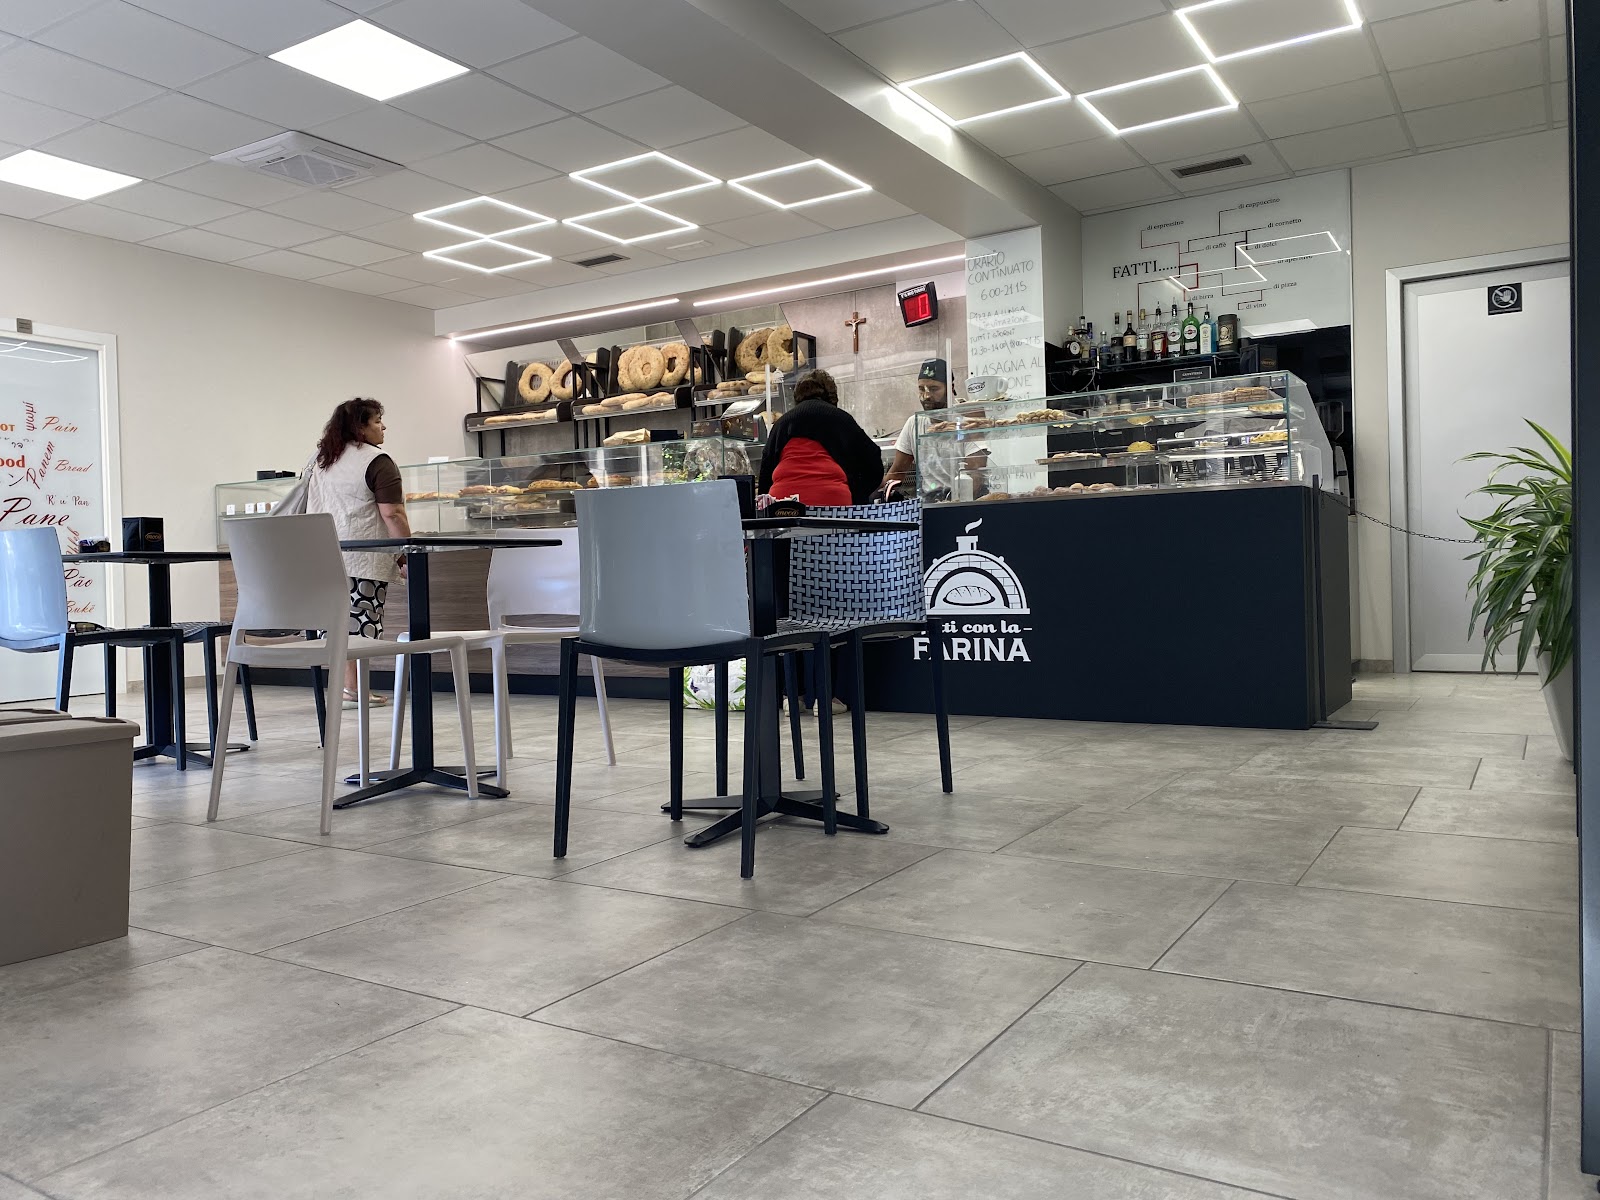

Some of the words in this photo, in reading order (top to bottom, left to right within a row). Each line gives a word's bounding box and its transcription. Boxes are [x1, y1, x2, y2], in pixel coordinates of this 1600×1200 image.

[1275, 218, 1301, 227] cornetto
[42, 416, 79, 433] Pain
[25, 440, 56, 490] Panem
[54, 459, 94, 473] Bread
[0, 497, 70, 526] Pane
[962, 624, 997, 634] con
[1000, 620, 1021, 634] la
